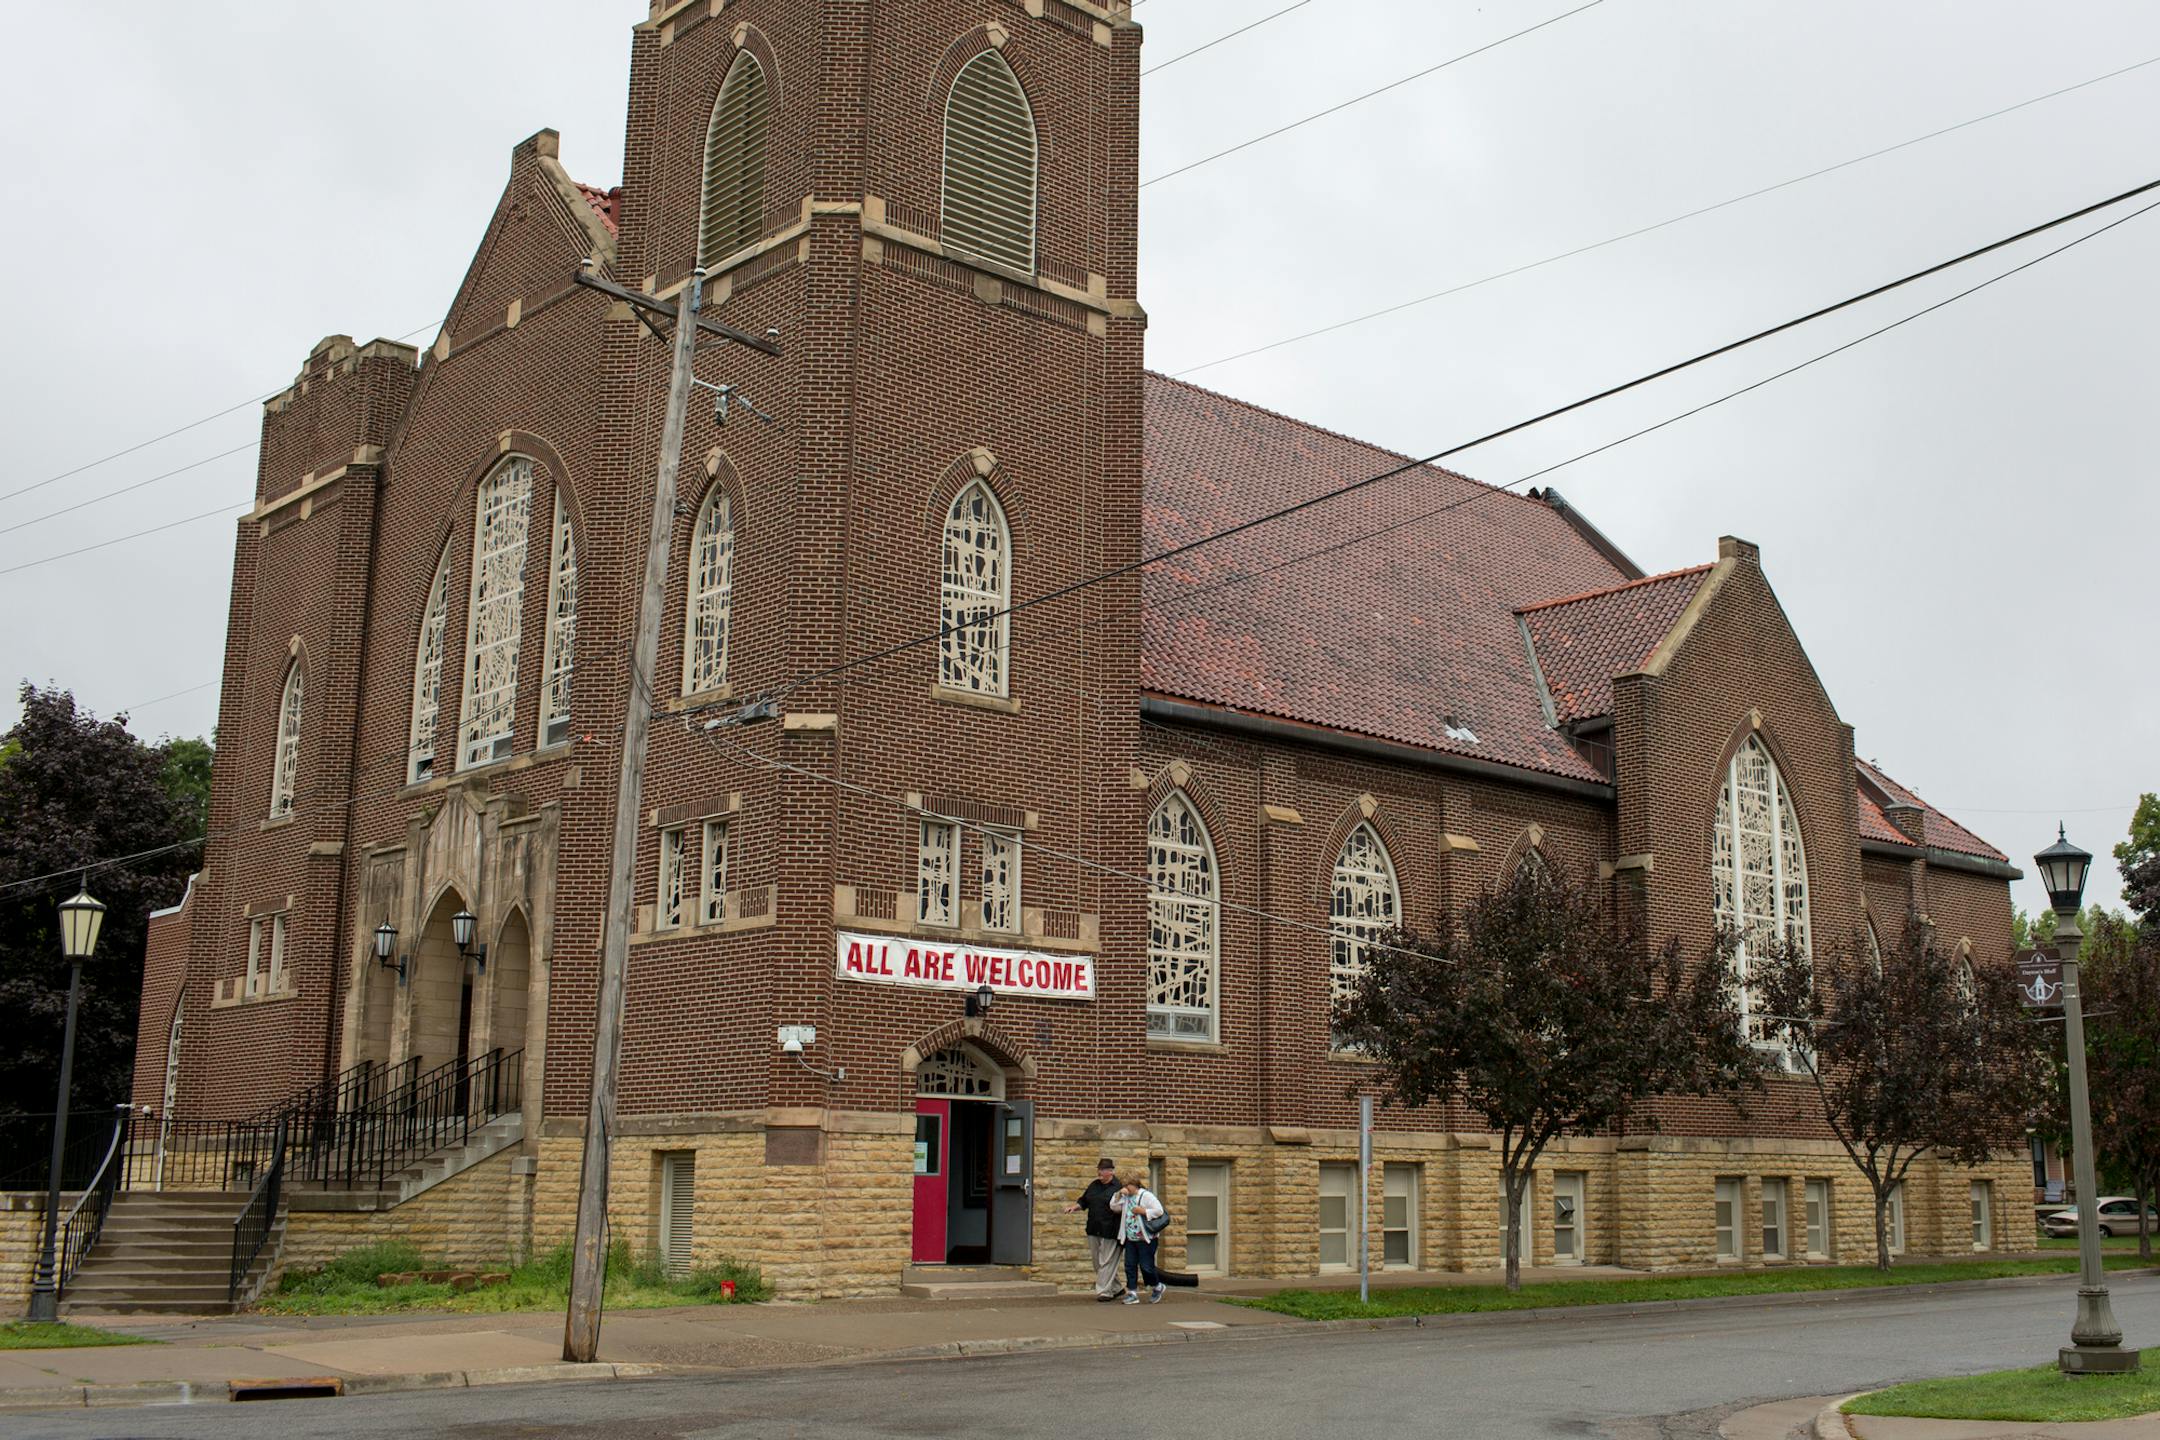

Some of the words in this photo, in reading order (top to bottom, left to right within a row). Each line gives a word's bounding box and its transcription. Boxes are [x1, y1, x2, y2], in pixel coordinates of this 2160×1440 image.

[846, 942, 893, 975] ALL
[904, 949, 955, 981] ARE
[965, 954, 1089, 991] WELCOME
